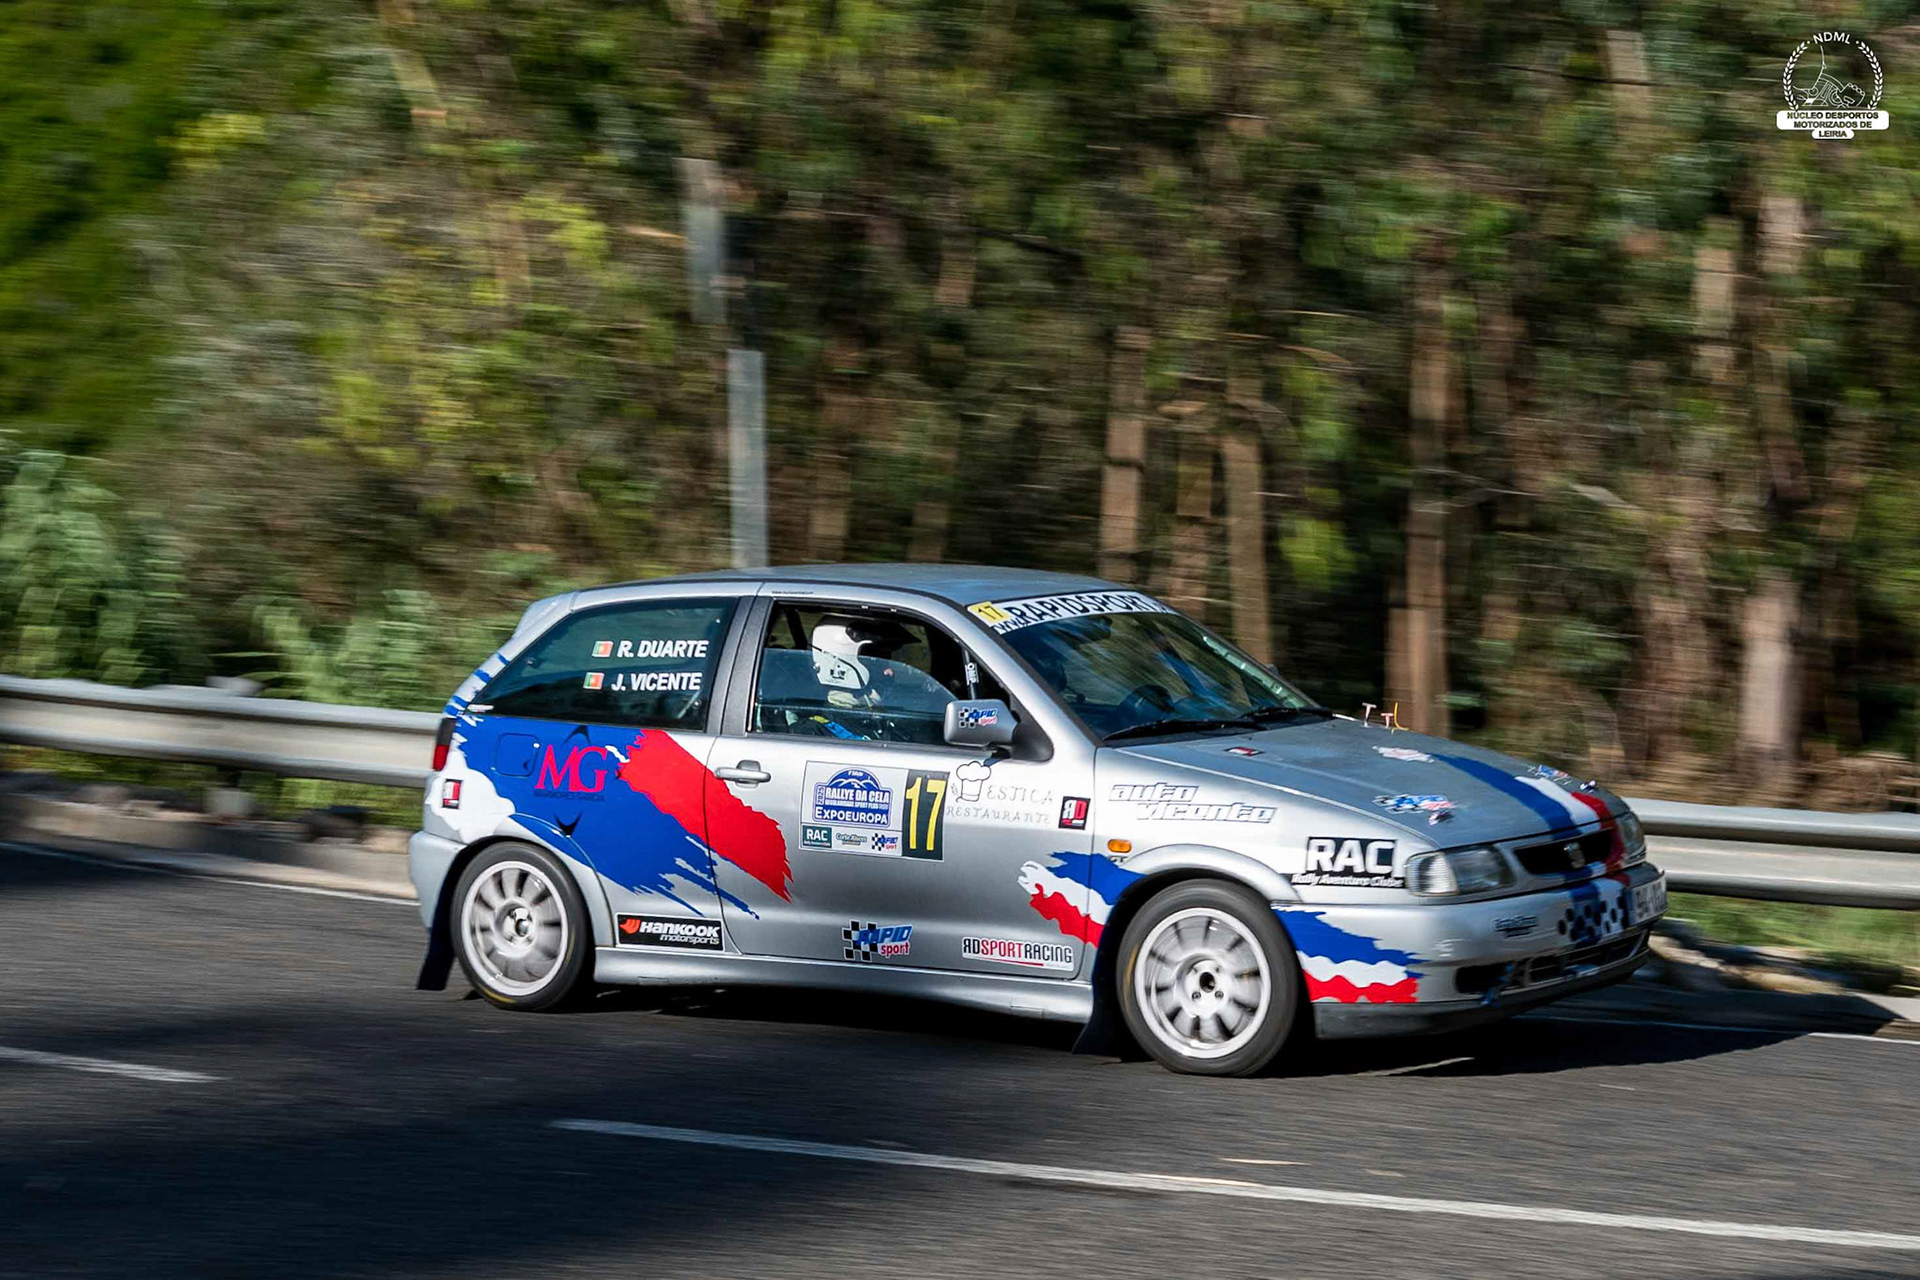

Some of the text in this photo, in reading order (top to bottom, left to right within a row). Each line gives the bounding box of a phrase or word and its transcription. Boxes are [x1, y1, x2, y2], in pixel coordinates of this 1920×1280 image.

[978, 604, 1004, 620] 17
[617, 640, 709, 658] R. DUARTE
[611, 672, 702, 691] J. VICENTE
[534, 744, 608, 793] MG
[825, 787, 890, 803] RALLYE DA CELA
[906, 777, 947, 851] 17
[806, 829, 829, 841] RAC
[1306, 838, 1395, 874] RAC
[660, 934, 720, 946] motorsports
[881, 941, 909, 957] sport
